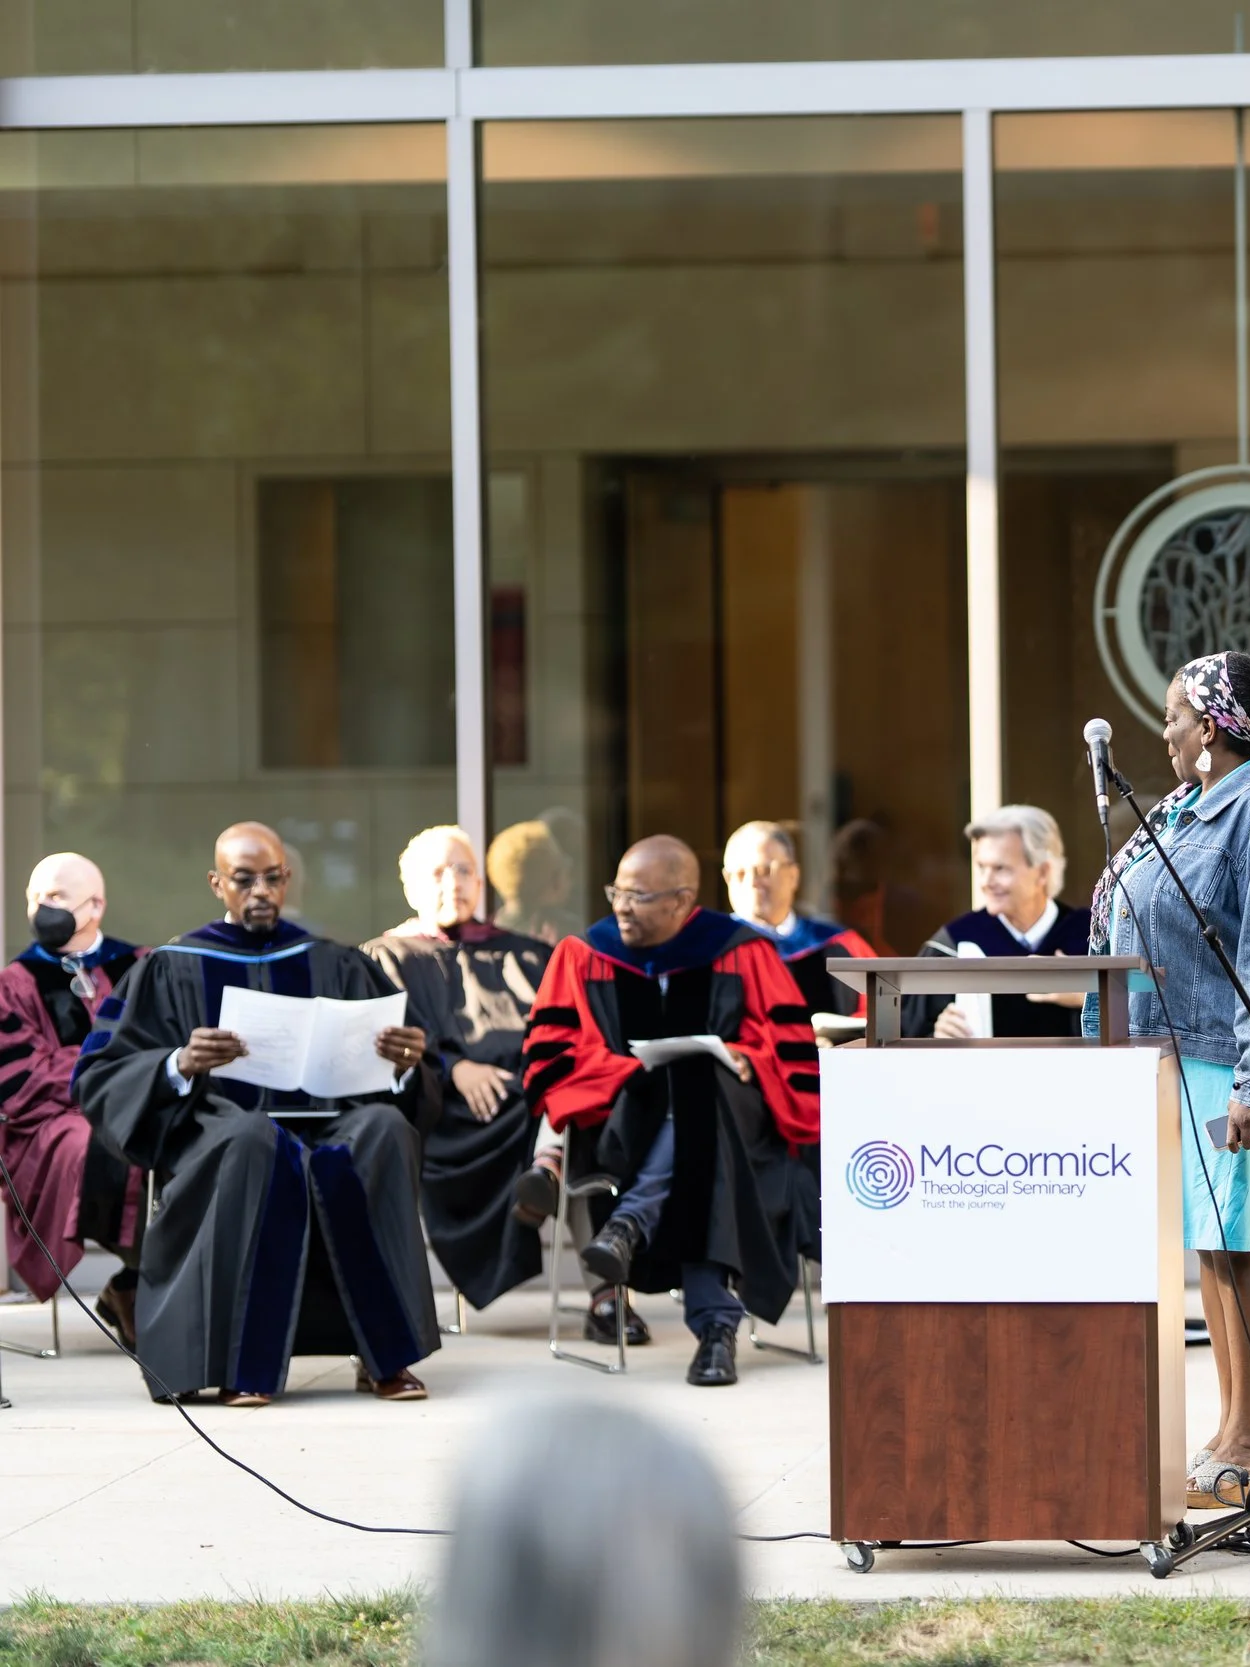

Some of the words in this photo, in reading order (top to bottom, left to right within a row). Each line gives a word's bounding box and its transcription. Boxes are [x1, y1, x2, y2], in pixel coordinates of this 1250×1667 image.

[921, 1143, 1132, 1177] McCormick
[921, 1180, 1009, 1198] Theological
[1012, 1180, 1087, 1198] Seminary
[921, 1199, 946, 1209] Trust
[948, 1199, 966, 1209] the
[967, 1199, 1006, 1210] journey
